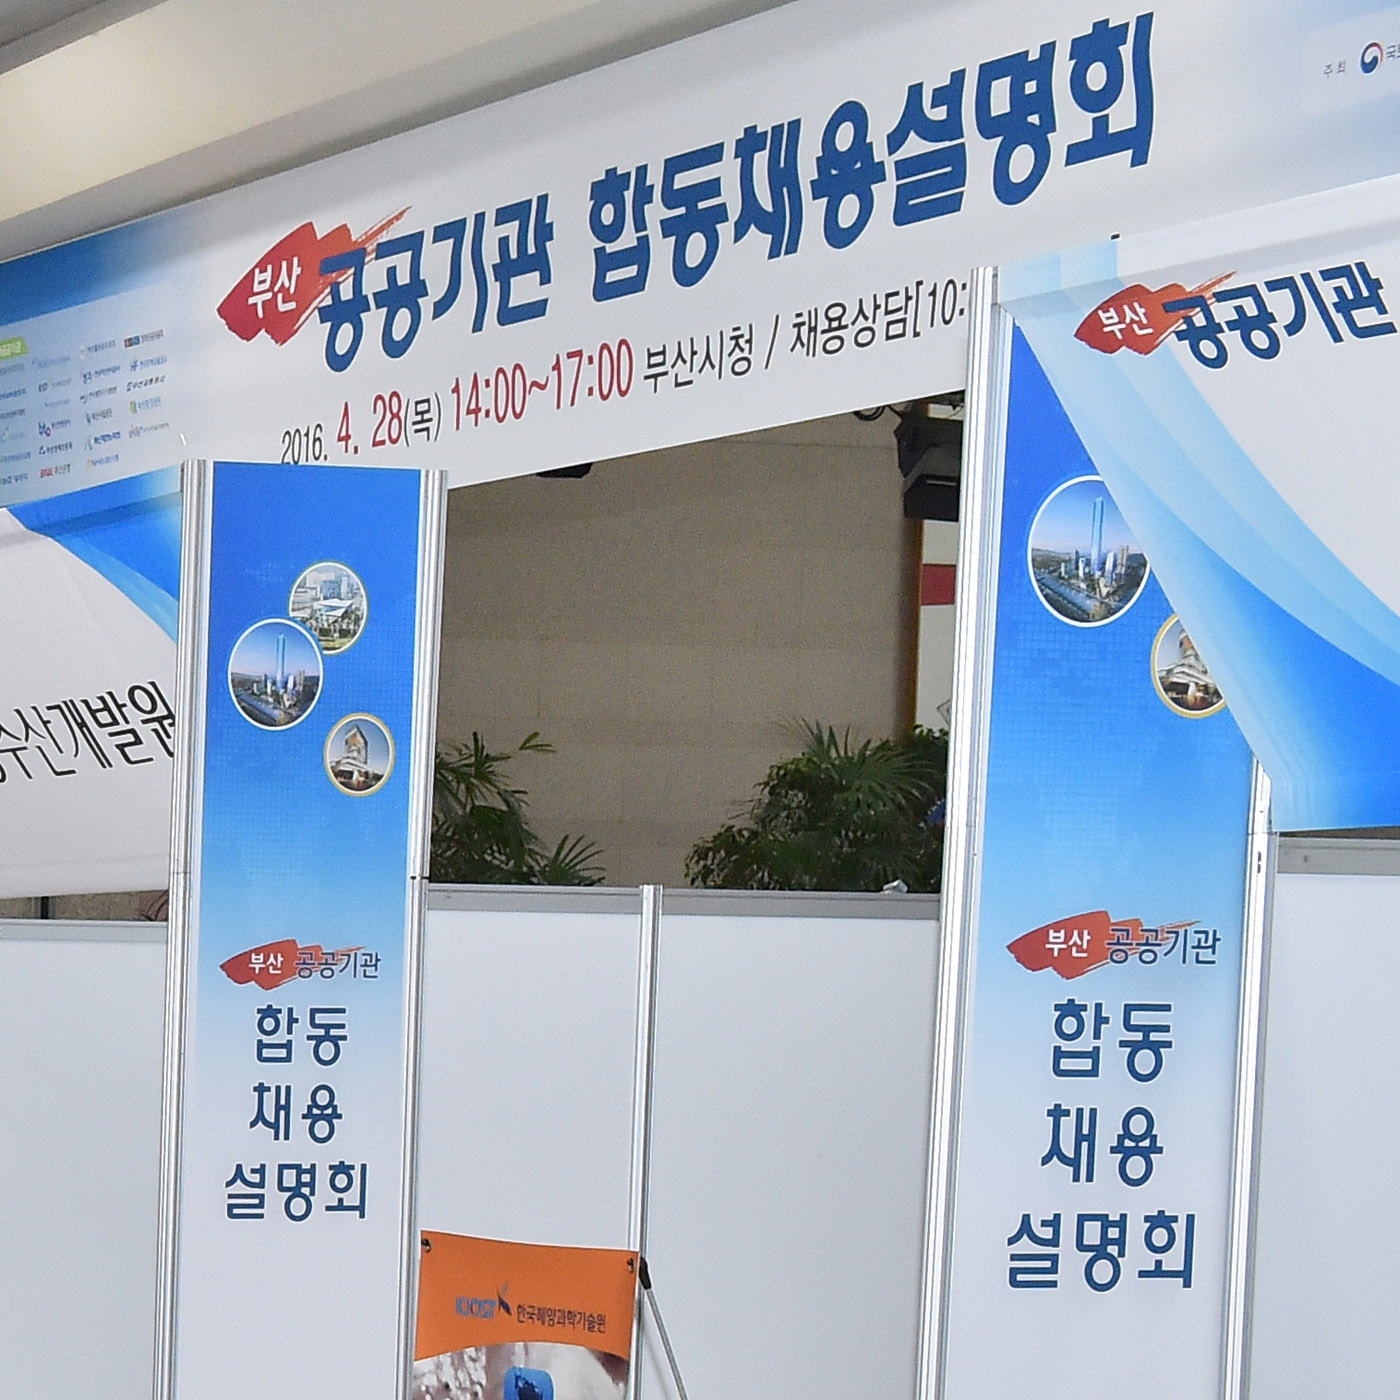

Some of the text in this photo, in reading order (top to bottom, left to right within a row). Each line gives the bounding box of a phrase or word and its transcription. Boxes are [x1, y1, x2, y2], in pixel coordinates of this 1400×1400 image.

[247, 11, 1155, 373] 부산 공공기관 합동채용설명회
[1097, 260, 1399, 370] 부산 공공기관
[281, 424, 329, 465] 2016.
[336, 402, 359, 454] 4.
[371, 389, 443, 449] 28(목)
[450, 337, 635, 432] 14:00~17:00
[643, 322, 754, 394] 부산시청
[248, 951, 381, 980] 부산 공공기관
[1045, 927, 1222, 966] 부산 공공기관
[256, 1004, 348, 1066] 합동
[1051, 998, 1174, 1083] 합동
[249, 1082, 343, 1144] 채용
[1040, 1102, 1164, 1188] 채용
[225, 1160, 368, 1222] 설명회
[1007, 1209, 1196, 1293] 설명회
[516, 1303, 607, 1334] 한국해양과학기술원
